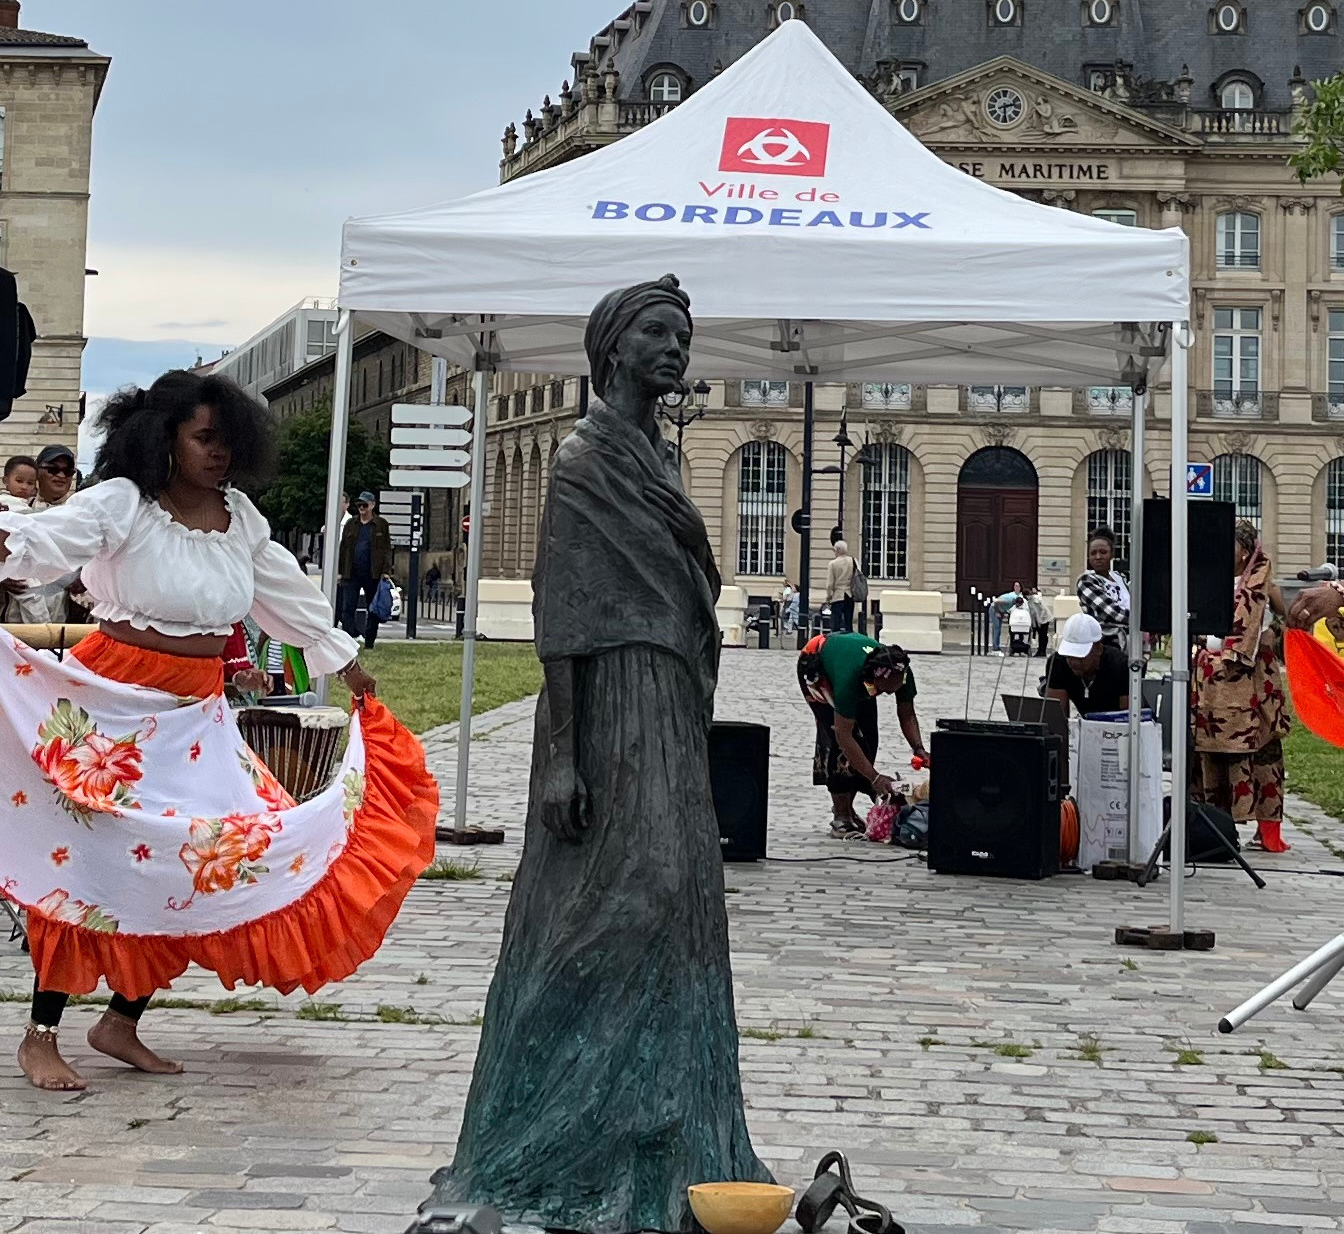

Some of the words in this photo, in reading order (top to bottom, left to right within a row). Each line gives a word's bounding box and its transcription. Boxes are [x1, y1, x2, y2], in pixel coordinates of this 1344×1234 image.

[998, 163, 1110, 180] MARITIME
[698, 181, 779, 201] Ville
[795, 187, 840, 203] de
[591, 200, 933, 229] BORDEAUX
